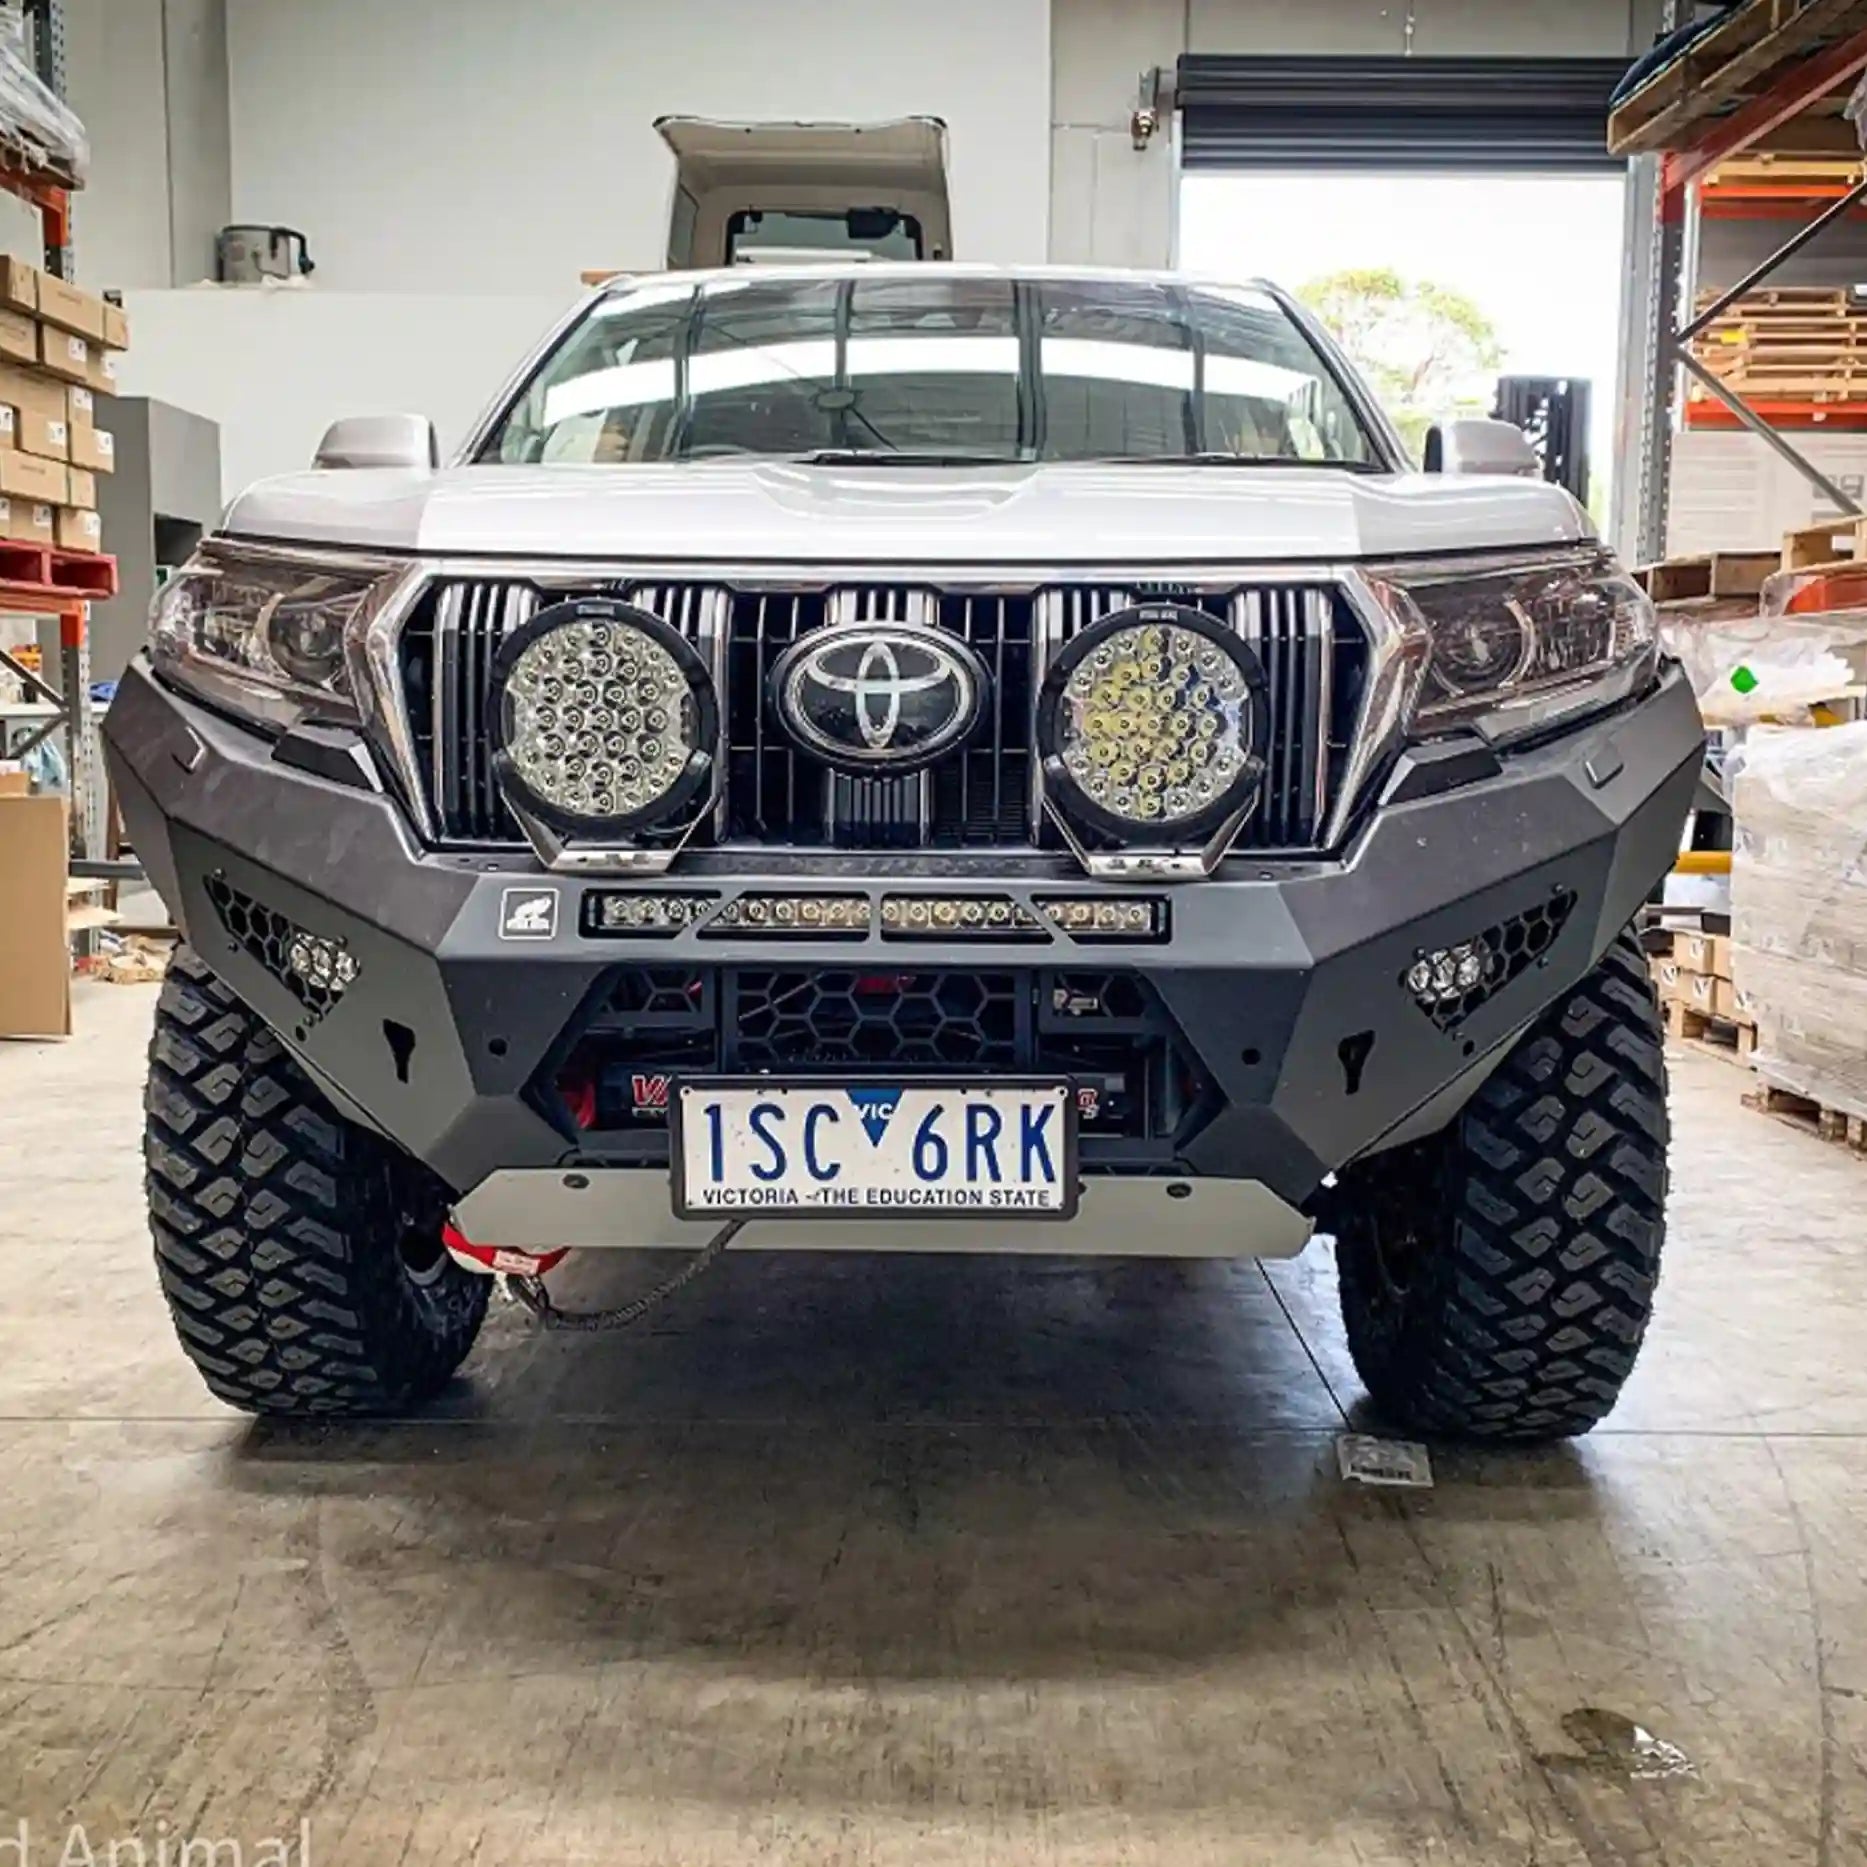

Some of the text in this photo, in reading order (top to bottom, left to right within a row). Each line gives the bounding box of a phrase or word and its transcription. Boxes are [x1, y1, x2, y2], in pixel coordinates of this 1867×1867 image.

[854, 1103, 893, 1120] VIC
[704, 1103, 841, 1182] 1SC
[913, 1103, 1056, 1183] 6RK
[702, 1187, 799, 1205] VICTORIA
[866, 1188, 983, 1205] EDUCATION
[989, 1188, 1050, 1207] STATE
